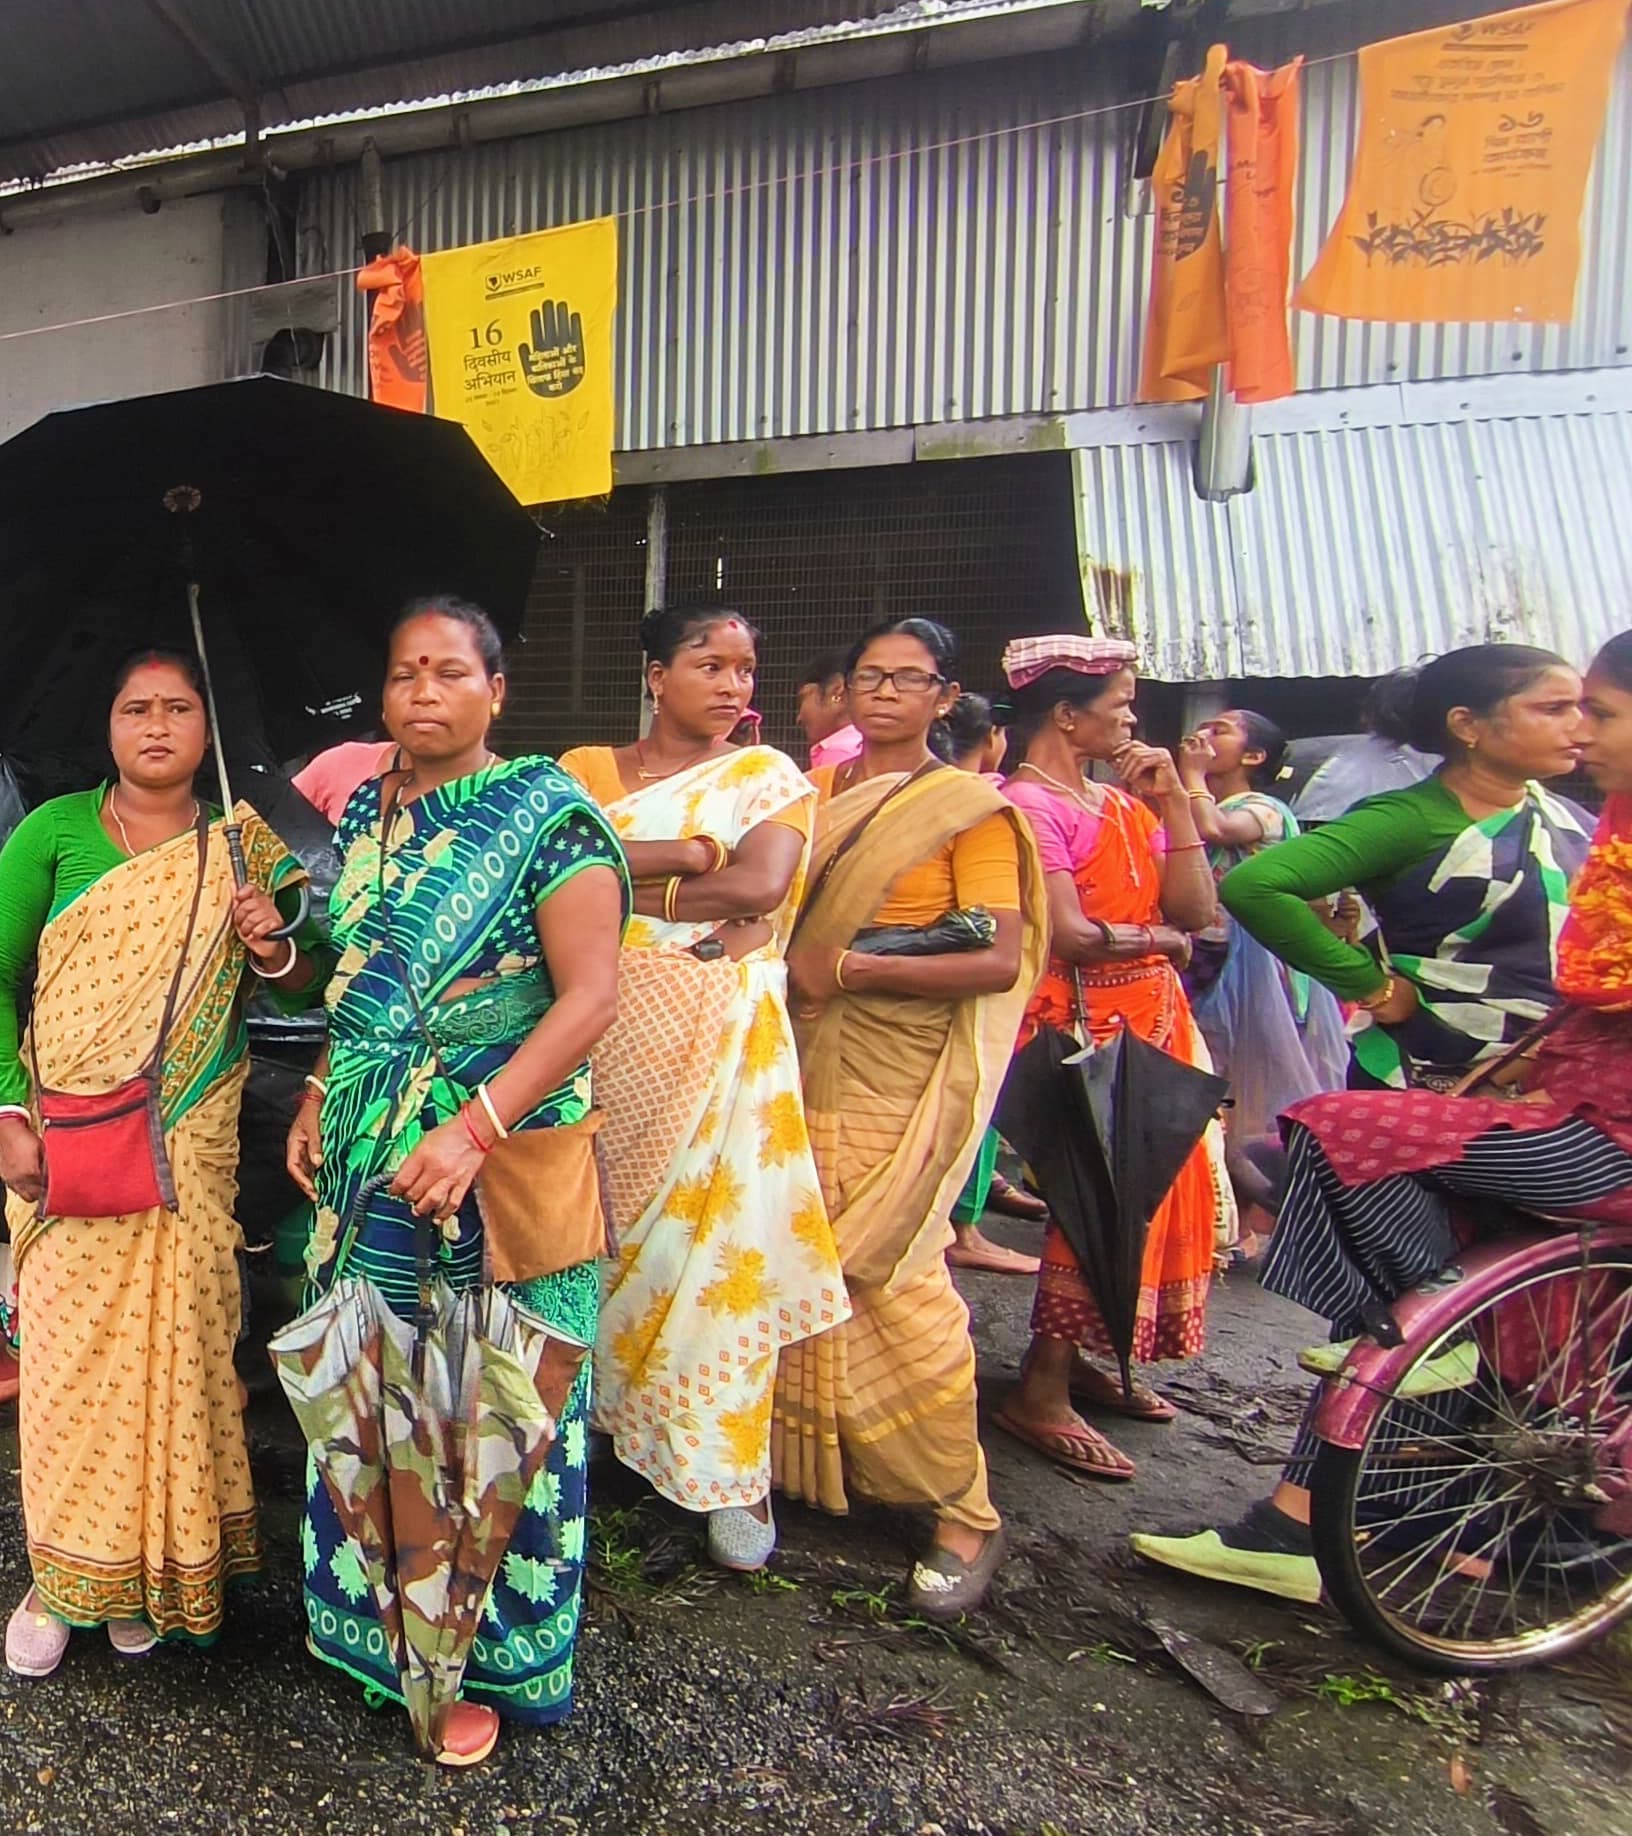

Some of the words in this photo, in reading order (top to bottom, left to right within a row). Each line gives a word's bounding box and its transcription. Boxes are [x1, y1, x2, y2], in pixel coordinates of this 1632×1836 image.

[503, 266, 542, 284] WSAF
[469, 319, 503, 349] 16
[463, 349, 512, 373] दिवसीय
[464, 370, 516, 391] अभियान
